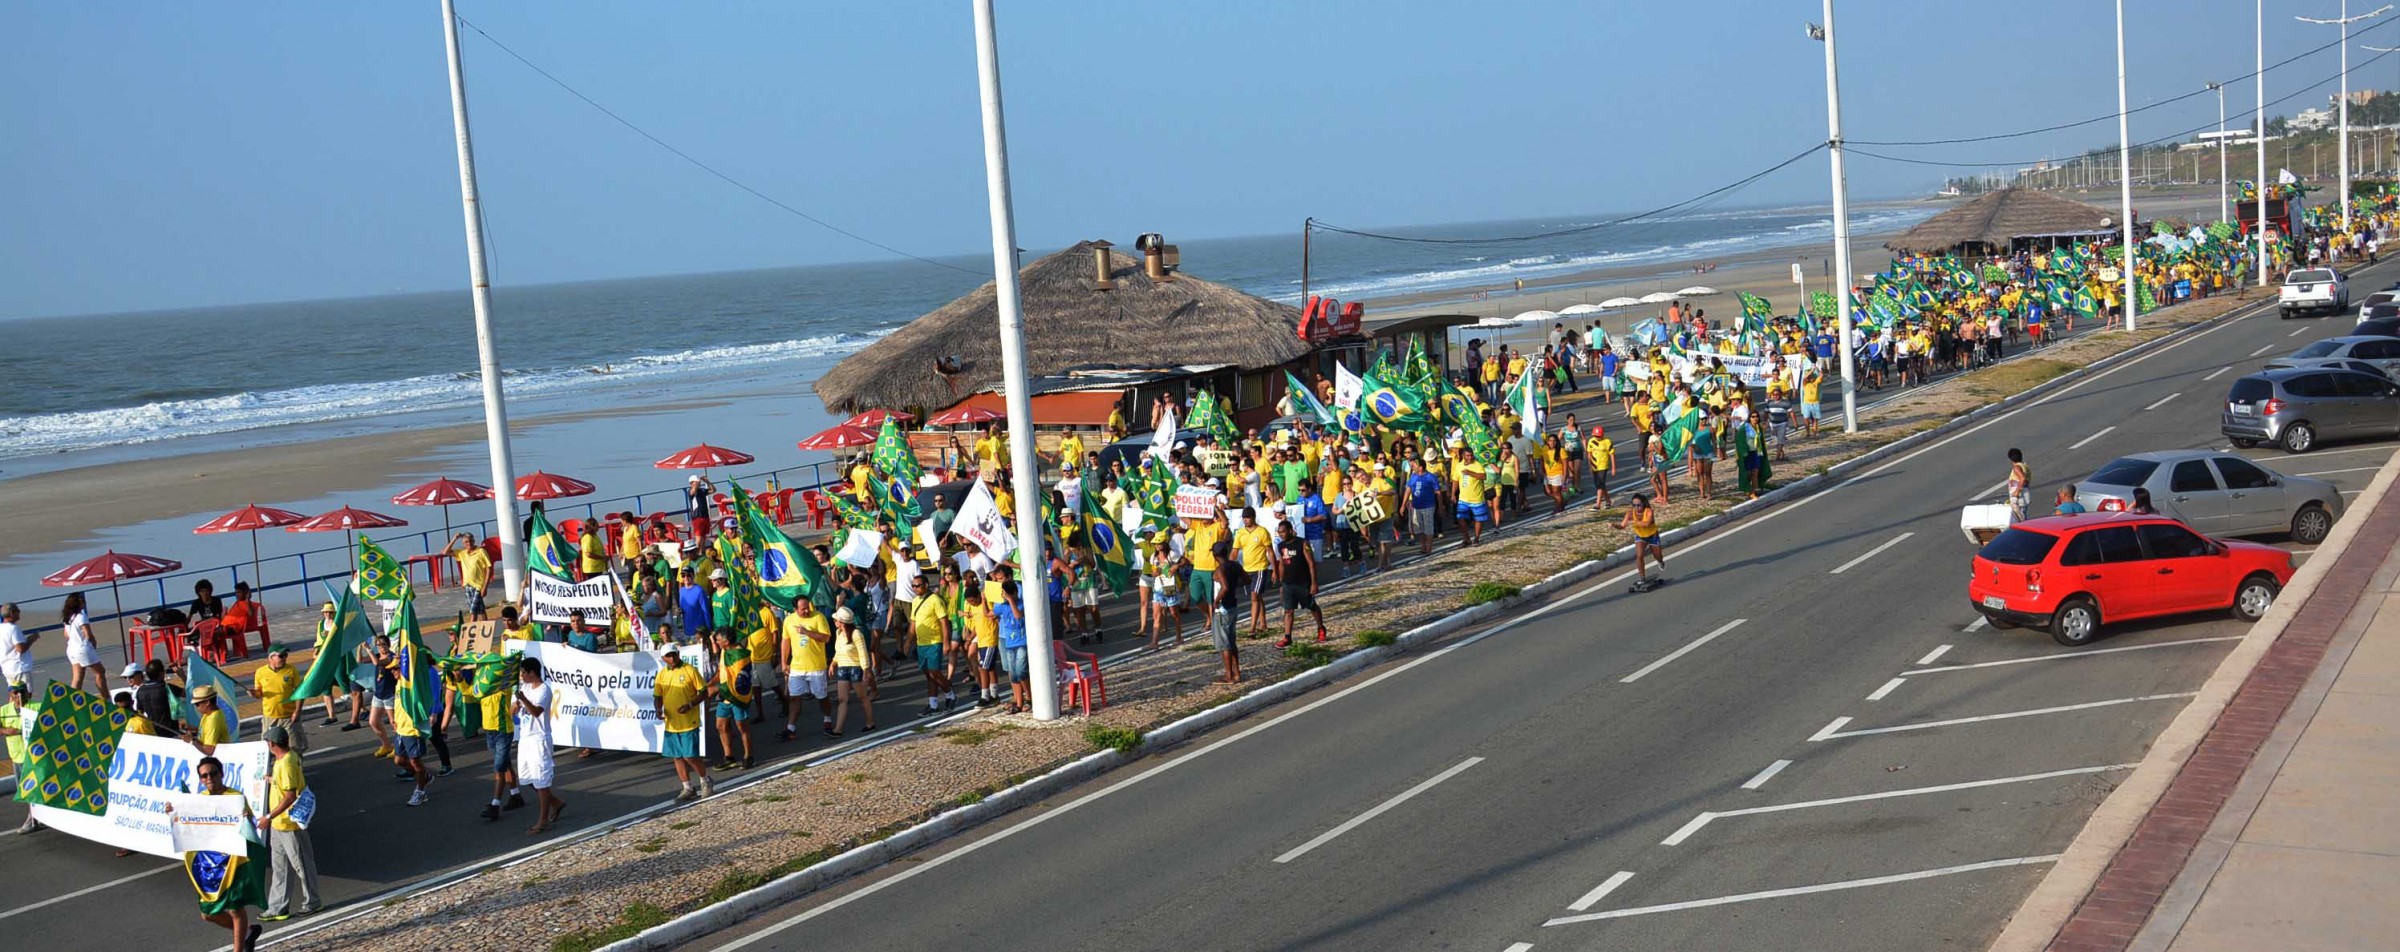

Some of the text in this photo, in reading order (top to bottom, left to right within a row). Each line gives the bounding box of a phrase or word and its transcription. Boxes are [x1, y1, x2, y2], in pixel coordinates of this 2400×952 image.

[1176, 504, 1213, 515] FEDERAL
[1349, 506, 1381, 532] TCU
[557, 583, 600, 598] RESPEITO
[543, 665, 658, 693] Atenção pela vid
[126, 751, 190, 792] AMA
[108, 791, 147, 814] RUPÇÃO,
